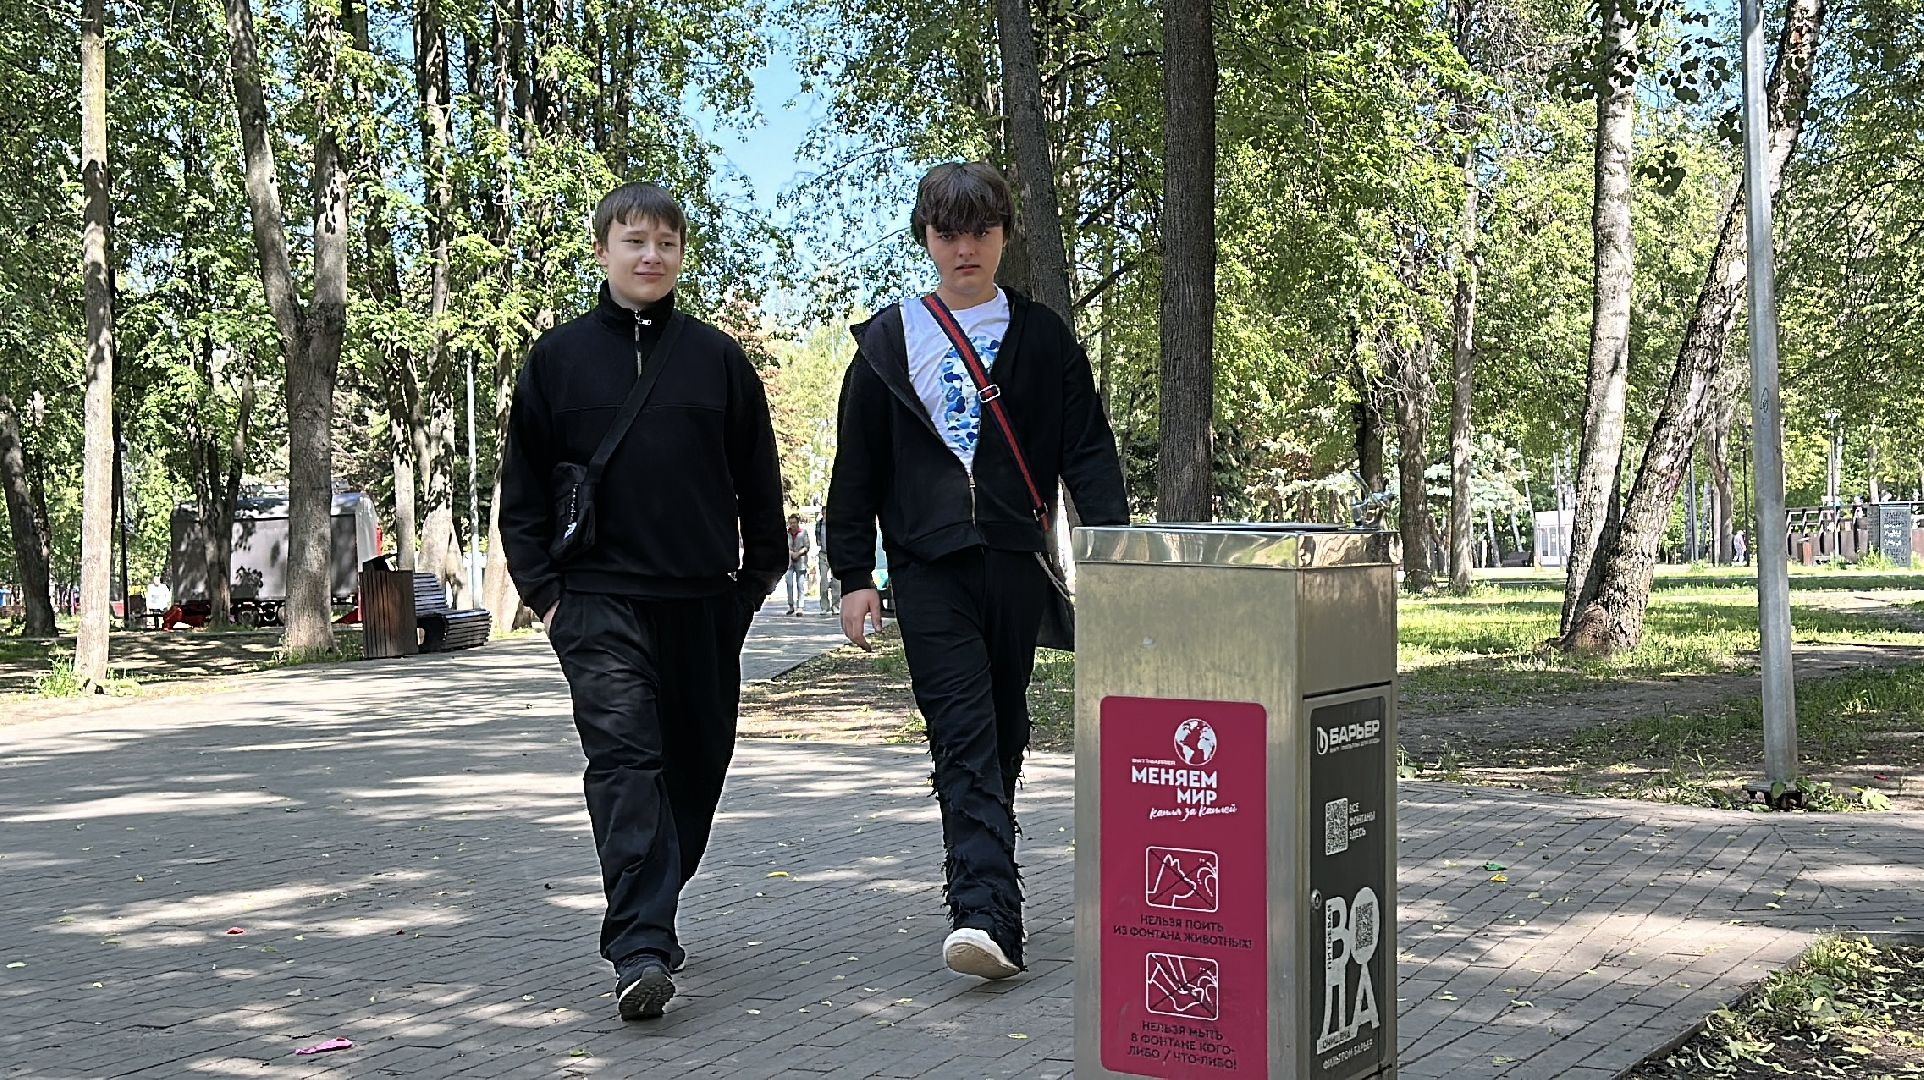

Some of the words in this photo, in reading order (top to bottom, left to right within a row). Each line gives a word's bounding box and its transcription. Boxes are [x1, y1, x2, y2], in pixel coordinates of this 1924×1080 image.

[1329, 720, 1380, 745] БАРЬЕР
[1131, 765, 1217, 789] МЕНЯЕМ
[1176, 787, 1217, 805] МИР
[1140, 914, 1182, 927] НЕЛЬЗЯ
[1185, 919, 1224, 932] ПОИТЬ
[1113, 925, 1128, 935] ИЗ
[1129, 928, 1181, 942] ФОНТАНА
[1184, 933, 1252, 949] ЖИВОТНЫХ!
[1142, 1020, 1186, 1035] НЕЛЬЗЯ
[1189, 1027, 1224, 1041] МЫТЬ
[1130, 1033, 1138, 1042] В
[1140, 1035, 1197, 1051] ФОНТАНЕ
[1200, 1042, 1236, 1055] КОГО-
[1127, 1046, 1160, 1058] ЛИБО
[1173, 1052, 1237, 1070] ЧТО-ЛИБО!
